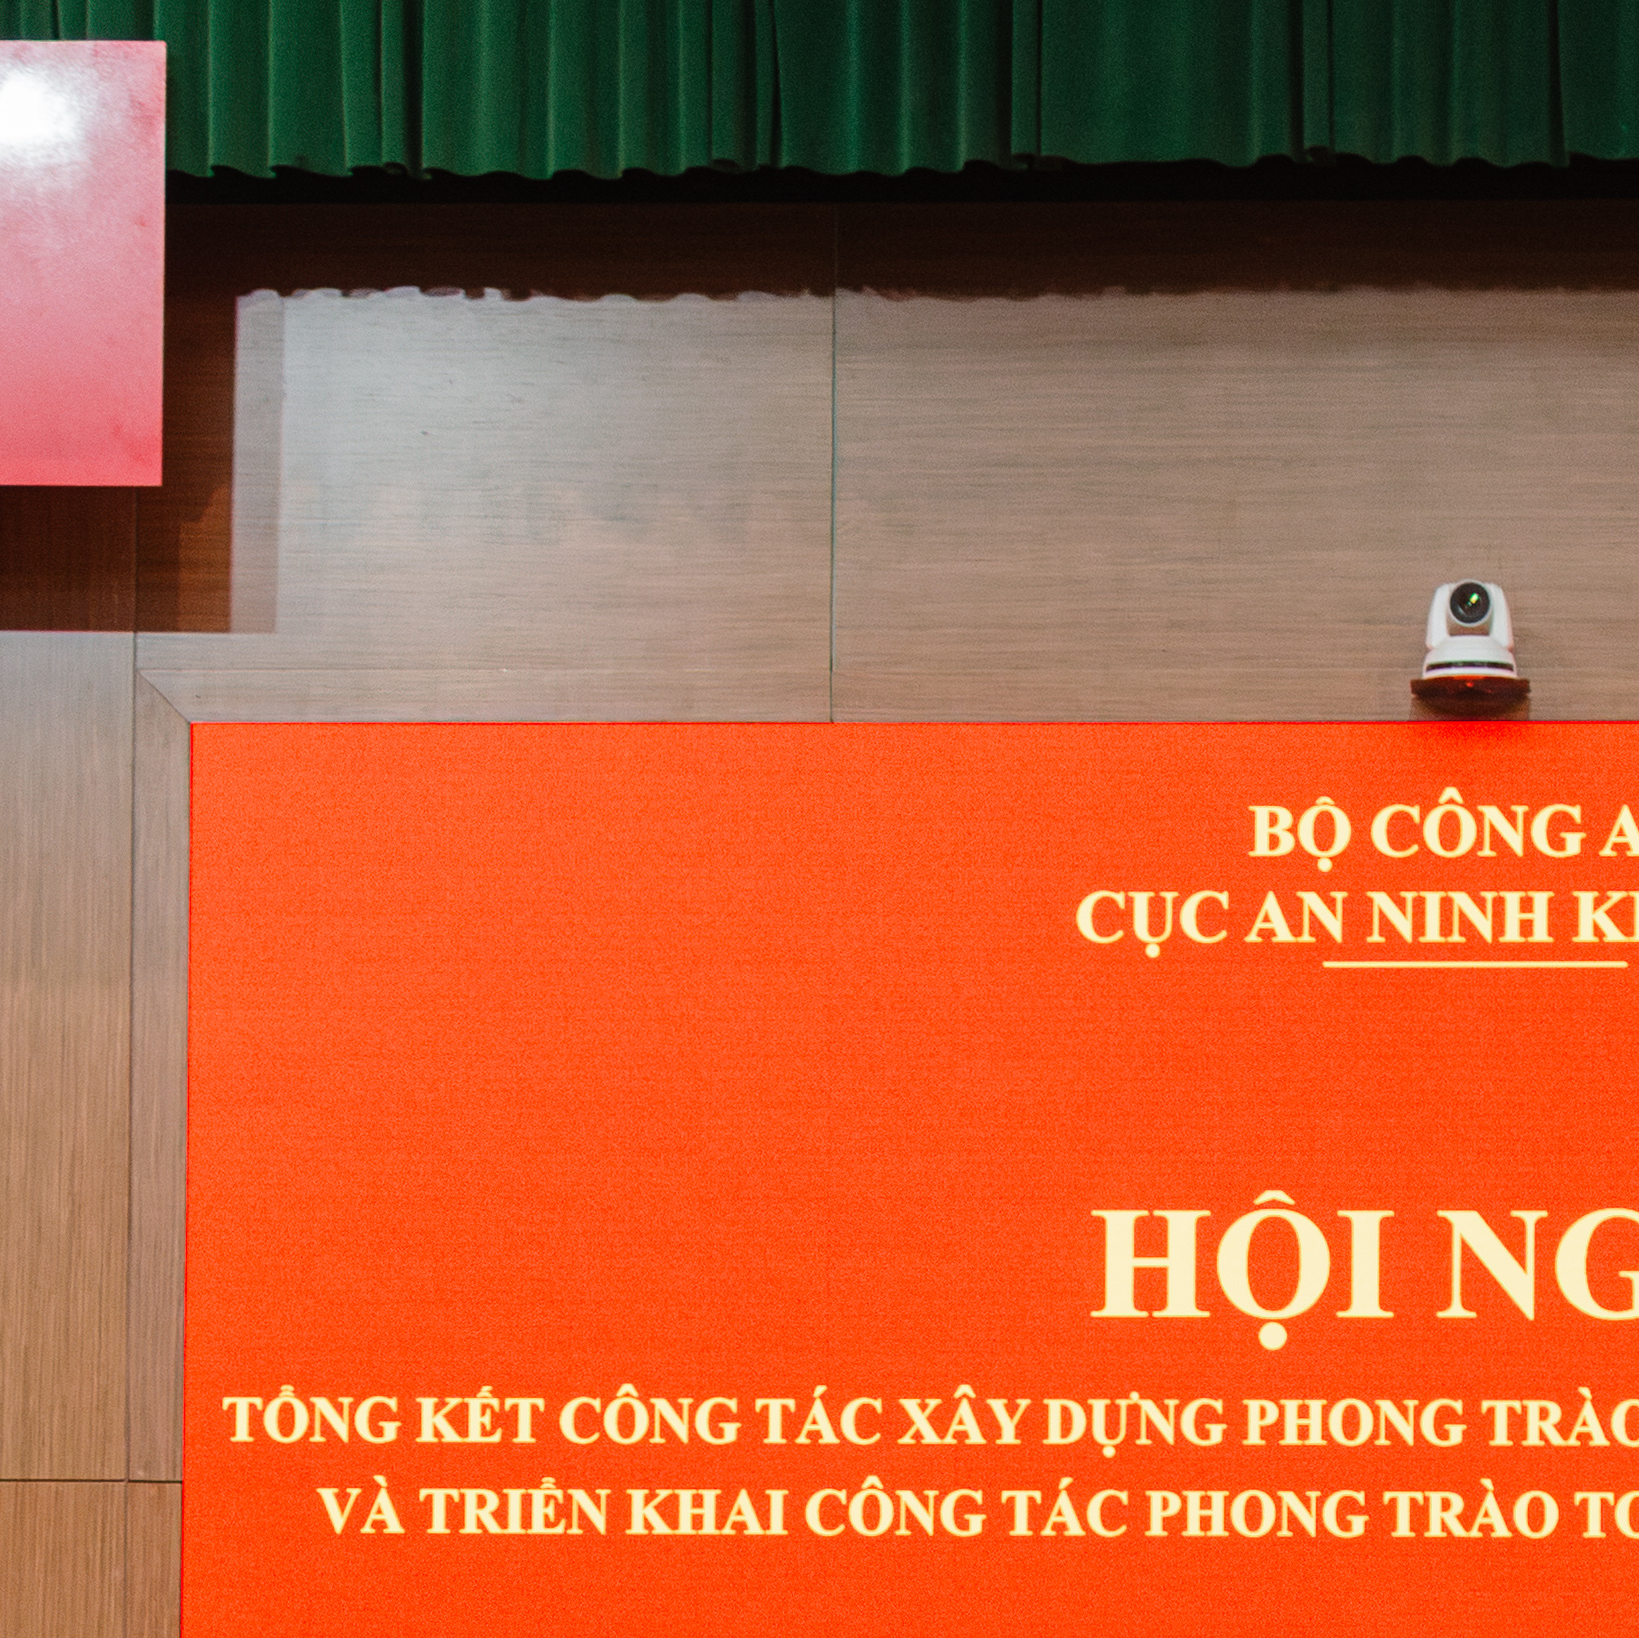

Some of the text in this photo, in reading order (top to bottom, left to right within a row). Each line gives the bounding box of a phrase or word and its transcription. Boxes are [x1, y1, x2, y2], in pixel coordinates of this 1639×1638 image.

[1249, 797, 1353, 874] BỘ
[1371, 787, 1587, 859] CÔNG
[1077, 891, 1230, 959] CỤC
[1245, 892, 1349, 944] AN
[1367, 892, 1555, 944] NINH
[1091, 1191, 1396, 1352] HỘI
[223, 1386, 402, 1445] TỔNG
[417, 1386, 546, 1444] KẾT
[560, 1384, 742, 1446] CÔNG
[756, 1386, 883, 1446] TÁC
[898, 1385, 1032, 1446] XÂY
[1044, 1392, 1228, 1459] DỰNG
[1244, 1399, 1468, 1448] PHONG
[317, 1476, 406, 1535] VÀ
[420, 1477, 612, 1536] TRIỂN
[627, 1490, 790, 1536] KHAI
[806, 1476, 987, 1538] CÔNG
[1002, 1478, 1129, 1538] TÁC
[1146, 1490, 1370, 1539] PHONG
[1384, 1479, 1560, 1540] TRÀO
